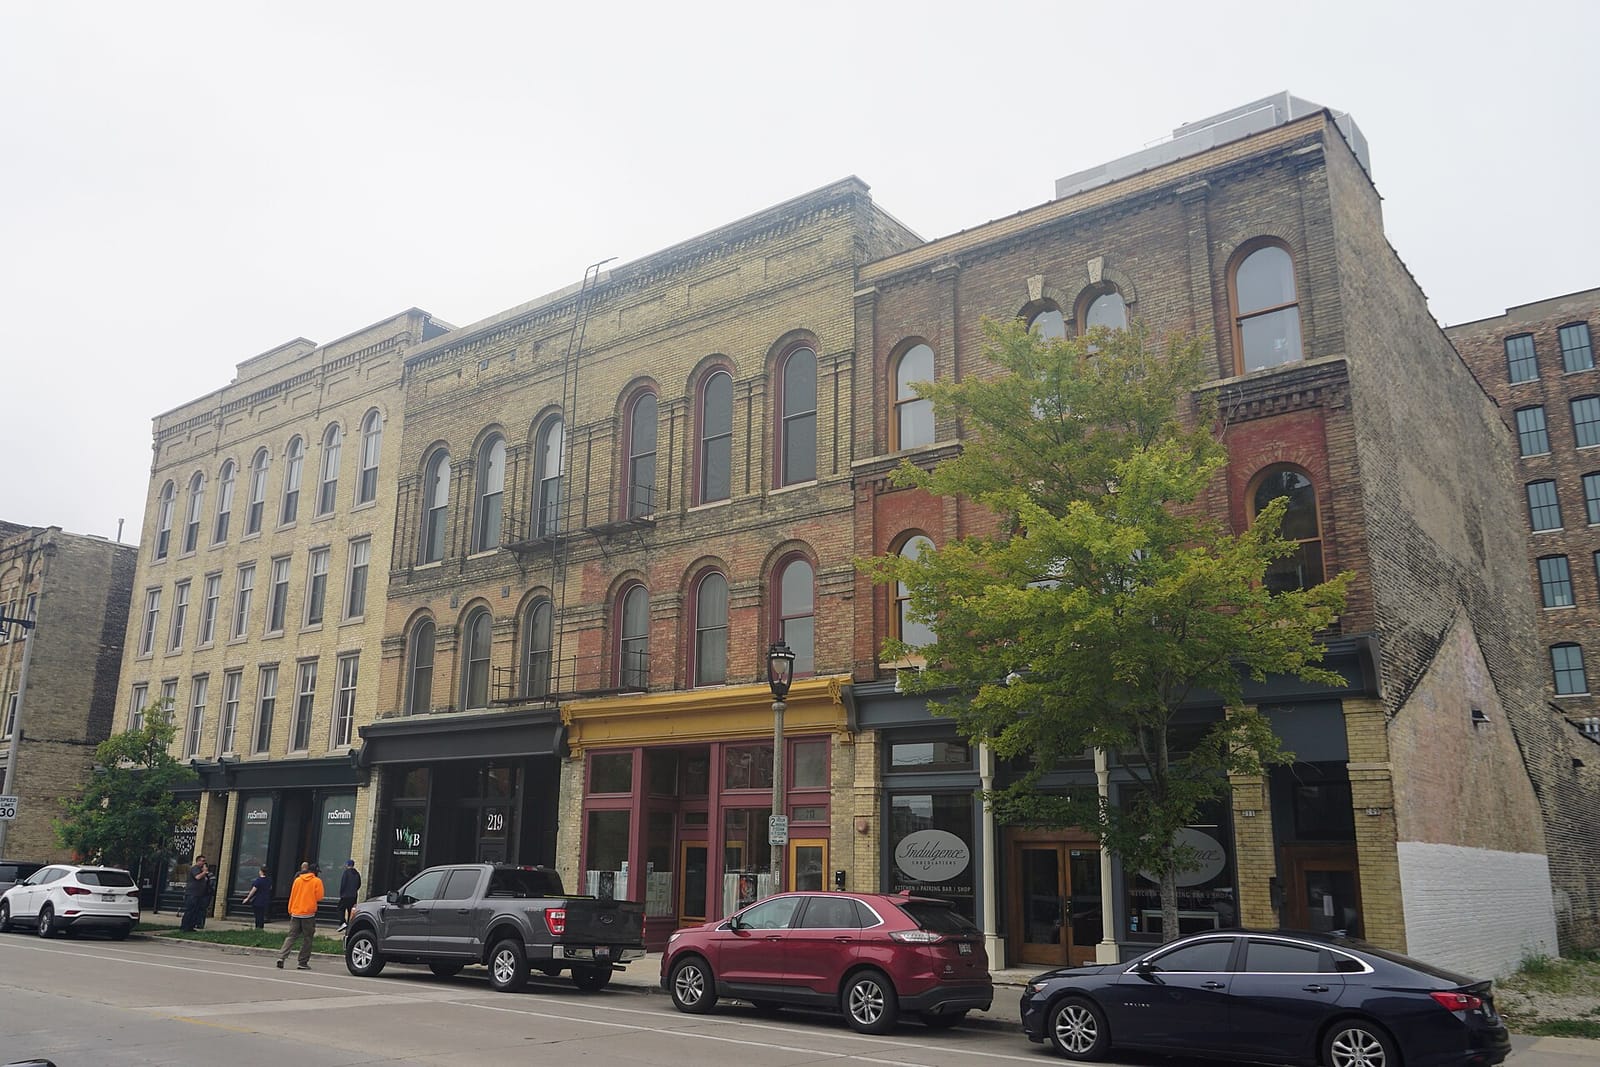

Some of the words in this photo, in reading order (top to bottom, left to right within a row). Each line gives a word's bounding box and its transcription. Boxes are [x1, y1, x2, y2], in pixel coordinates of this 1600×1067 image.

[0, 808, 15, 817] 30
[487, 814, 503, 831] 219
[770, 817, 776, 826] 2
[899, 841, 966, 870] Indulgence
